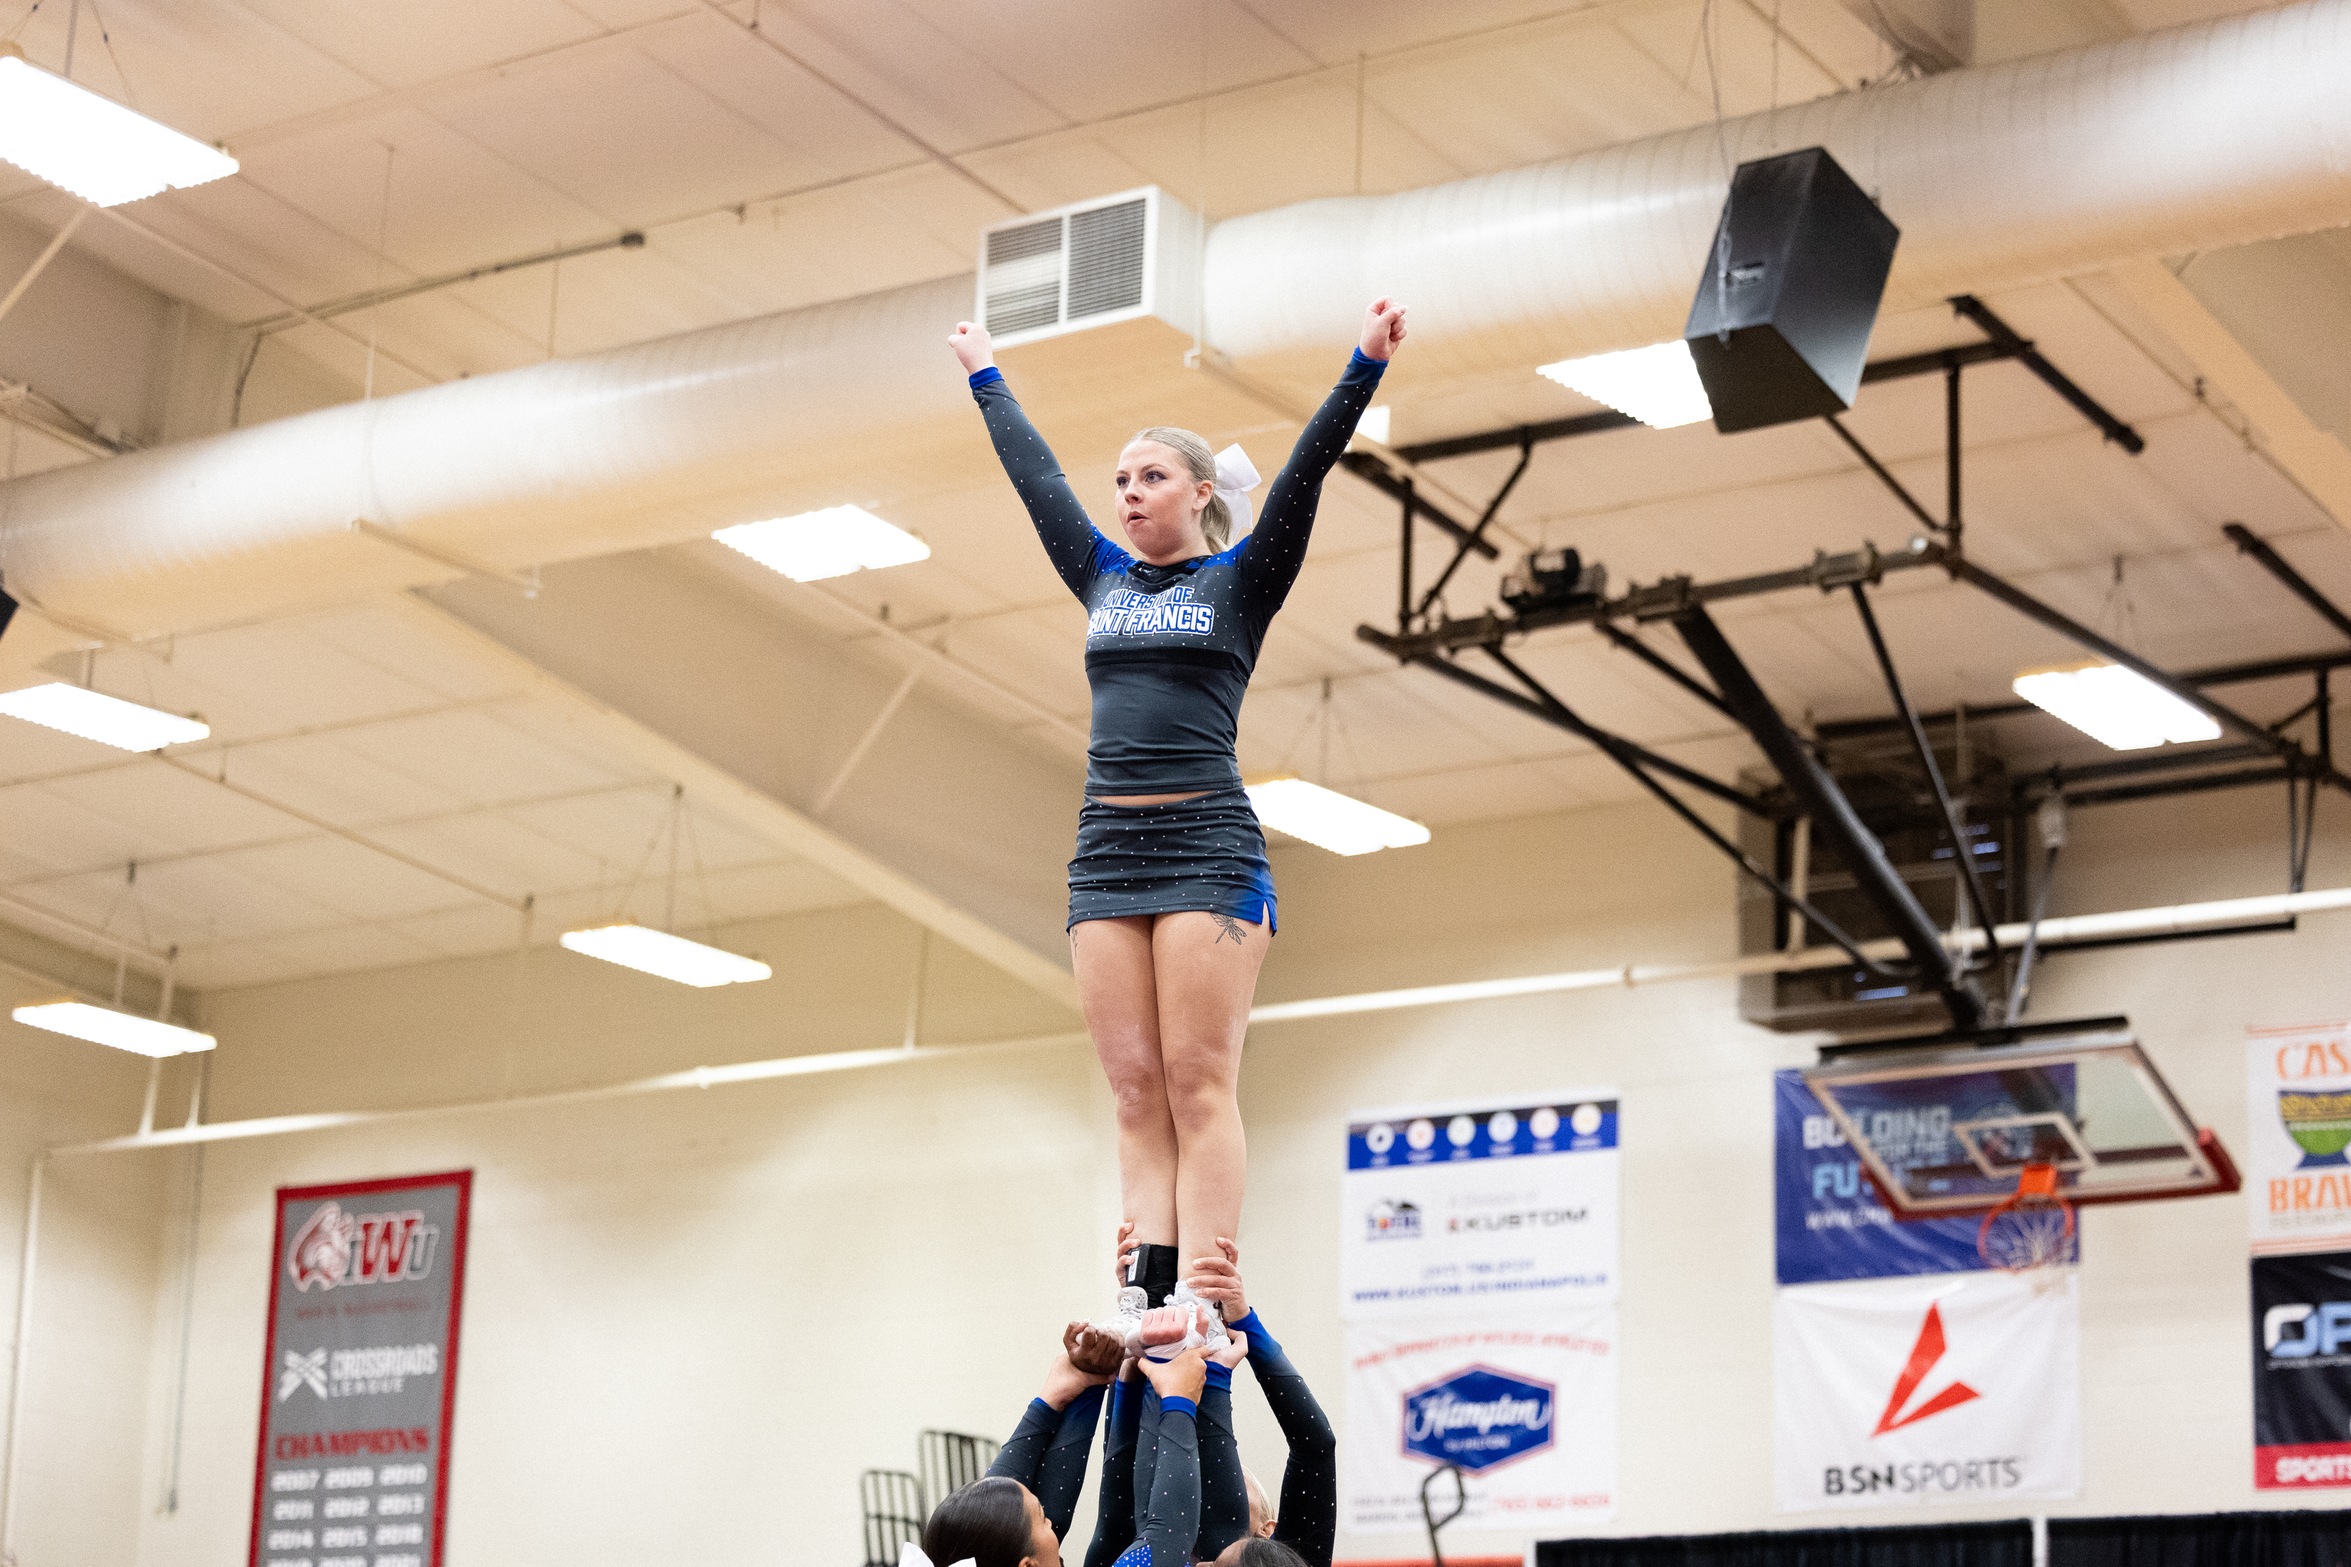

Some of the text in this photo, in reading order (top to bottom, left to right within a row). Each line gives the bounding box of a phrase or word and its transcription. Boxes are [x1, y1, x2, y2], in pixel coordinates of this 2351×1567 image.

[1172, 585, 1195, 604] OF
[1088, 602, 1215, 638] AINT FRANCIS
[330, 1343, 439, 1380] CROSSROADS
[329, 1376, 405, 1398] LEAGUE
[1405, 1392, 1552, 1442] Hampton
[275, 1427, 429, 1461] CHAMPIONS
[271, 1469, 321, 1492] 2007
[267, 1529, 314, 1550] 2014
